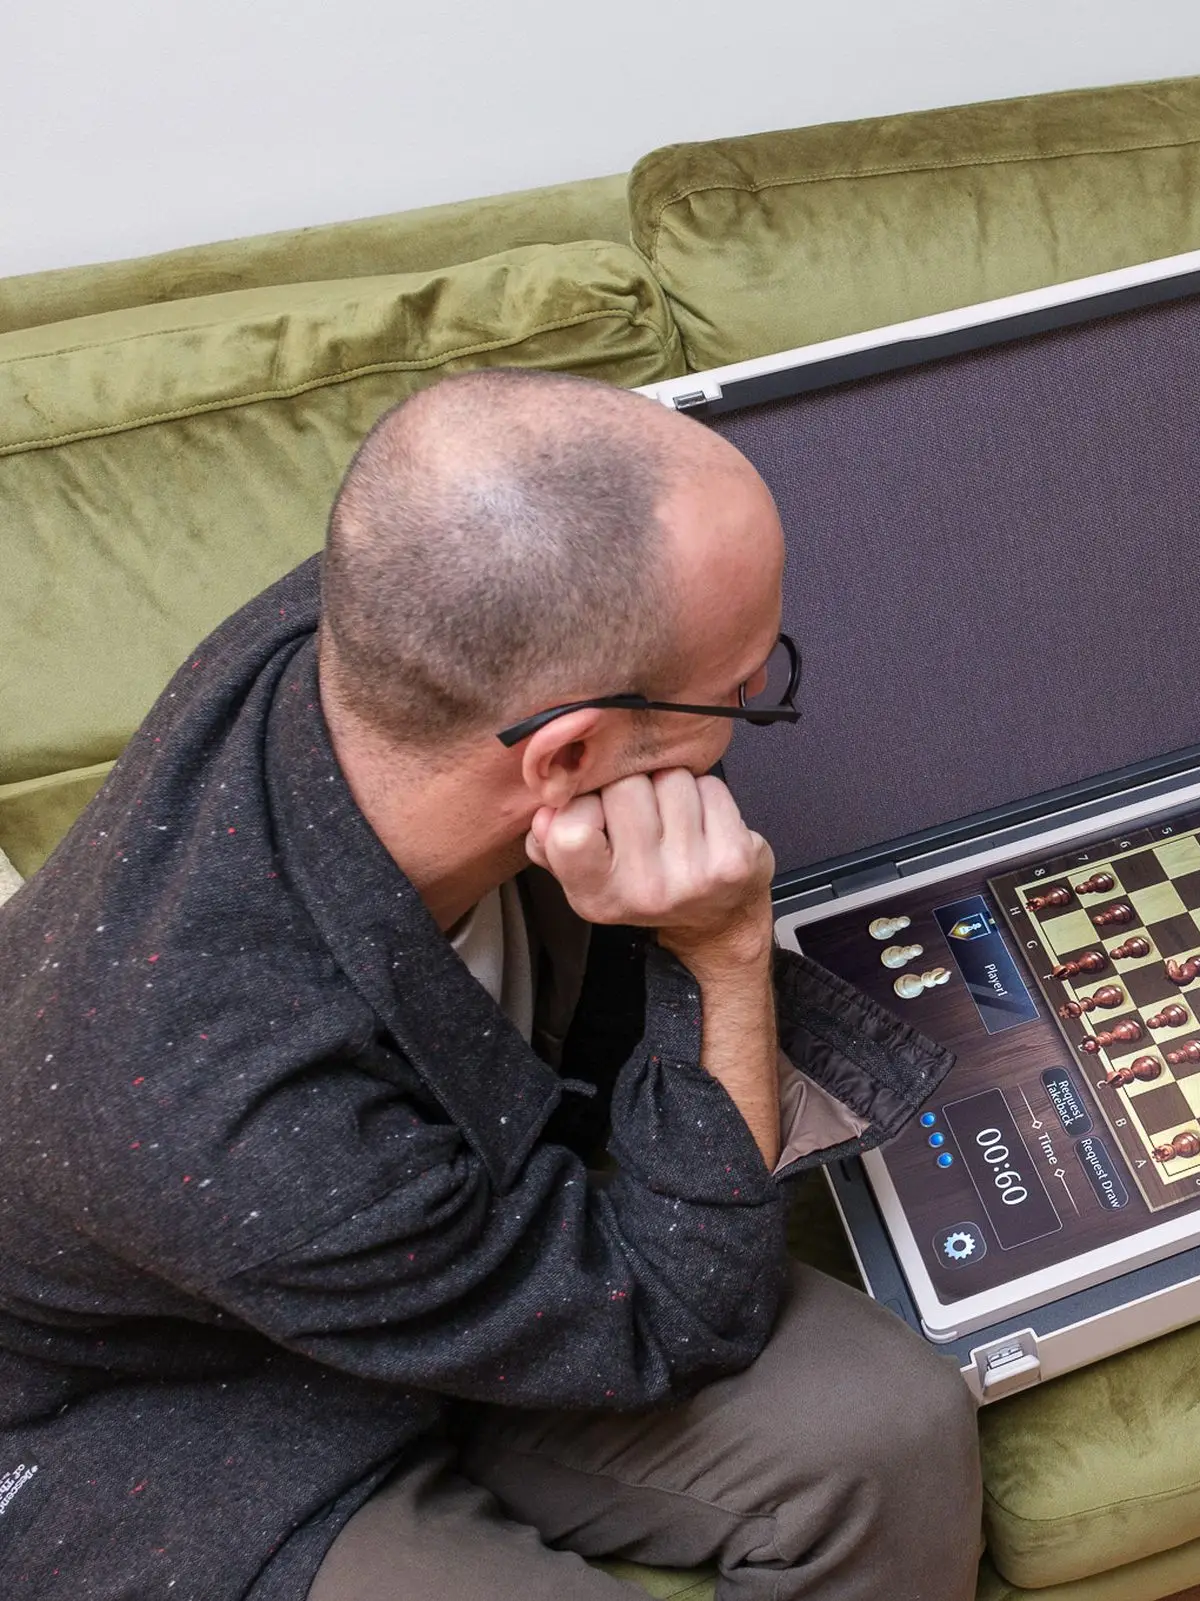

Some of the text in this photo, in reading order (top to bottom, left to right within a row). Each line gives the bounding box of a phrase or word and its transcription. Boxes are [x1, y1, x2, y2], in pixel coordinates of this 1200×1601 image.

[1034, 868, 1045, 877] 8
[1120, 841, 1131, 849] 6
[1162, 826, 1173, 835] 5
[984, 964, 1008, 997] Player1
[1009, 907, 1021, 916] H
[1026, 940, 1038, 949] G
[1115, 1118, 1127, 1127] B
[1135, 1159, 1147, 1169] A
[1046, 1081, 1073, 1126] Takeback
[1058, 1080, 1084, 1119] Request
[976, 1128, 1028, 1205] 00:60
[1038, 1132, 1058, 1164] Time
[1081, 1138, 1120, 1208] Request Draw
